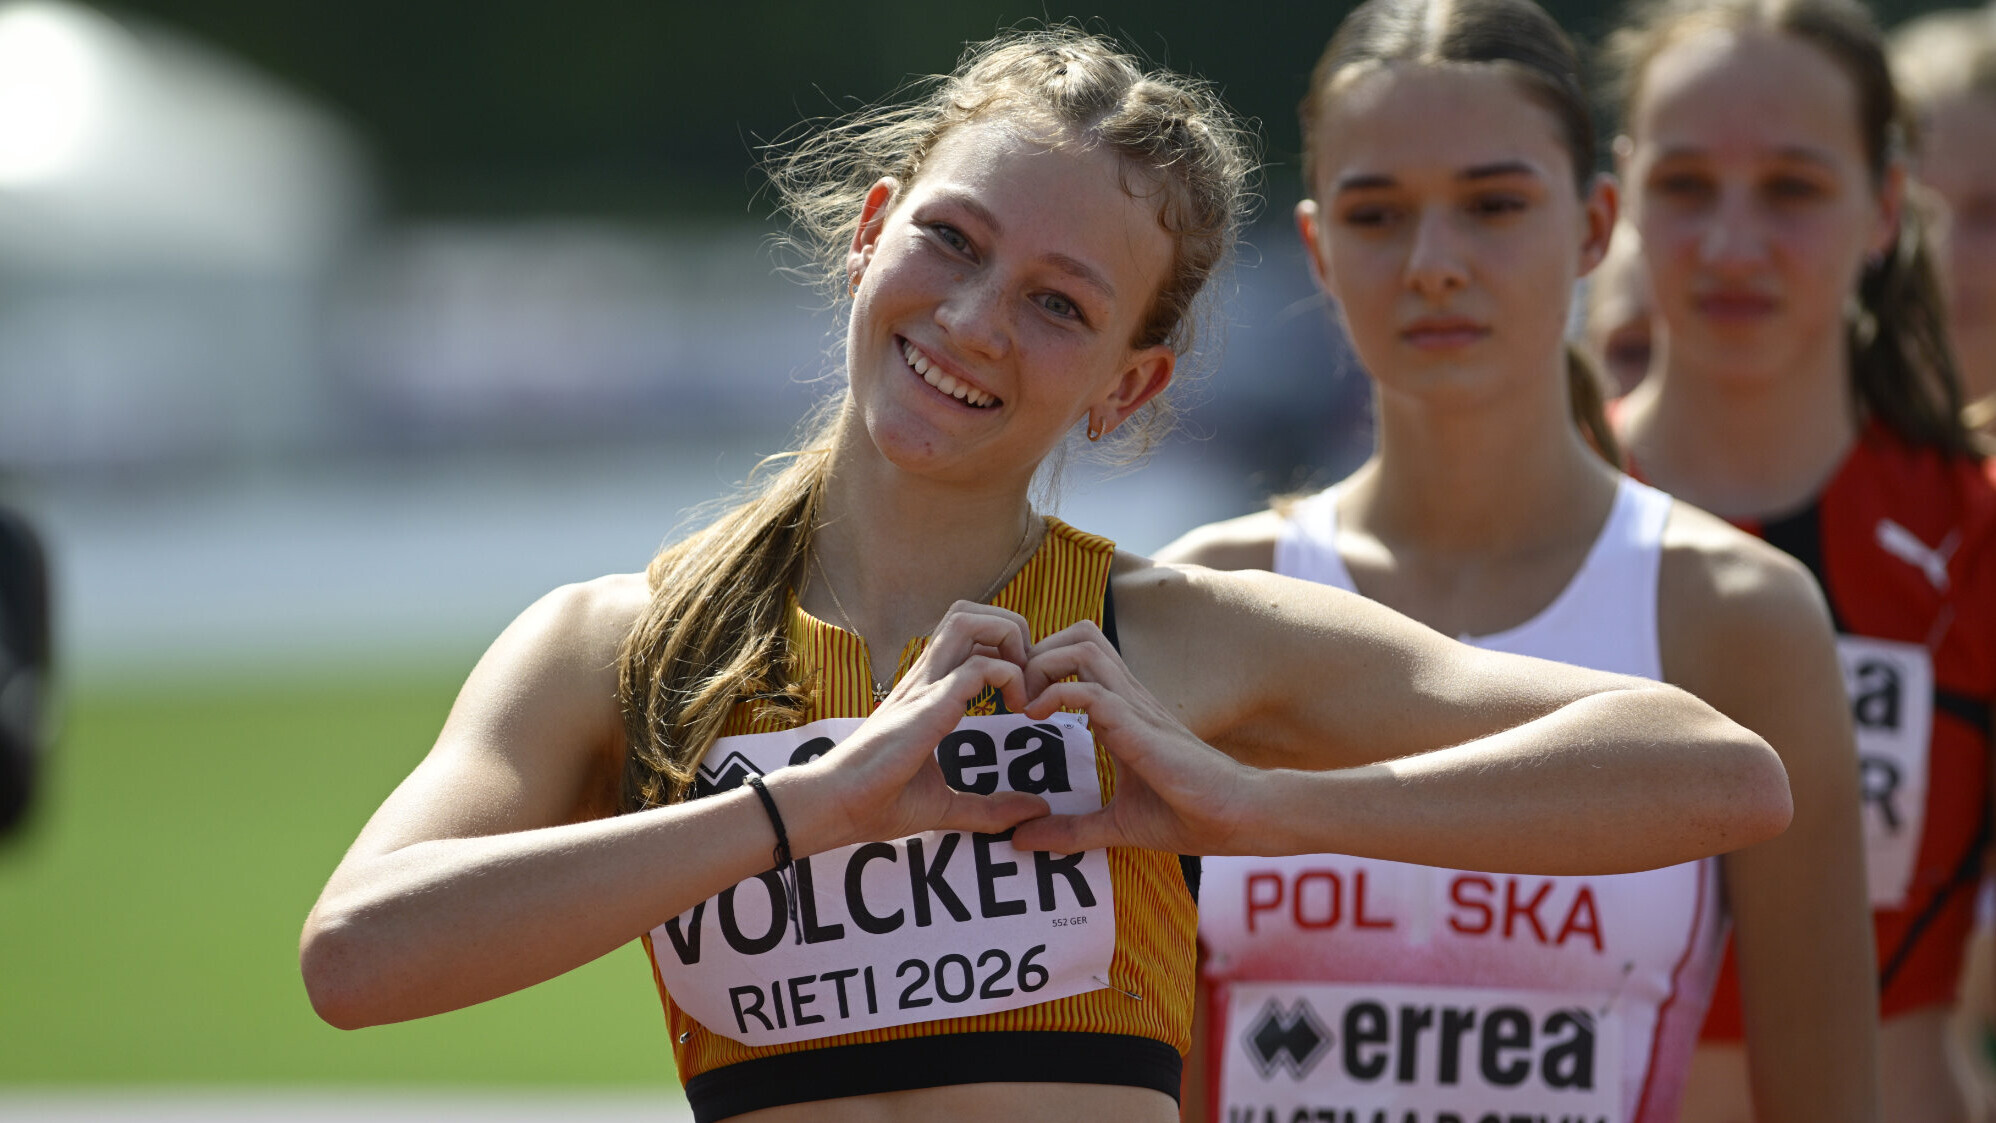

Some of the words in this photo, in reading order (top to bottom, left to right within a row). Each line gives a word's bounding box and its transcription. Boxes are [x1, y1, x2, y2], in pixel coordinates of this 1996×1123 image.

[1052, 918, 1068, 928] 552
[1070, 916, 1088, 926] GER
[728, 965, 878, 1034] RIETI
[895, 943, 1050, 1011] 2026
